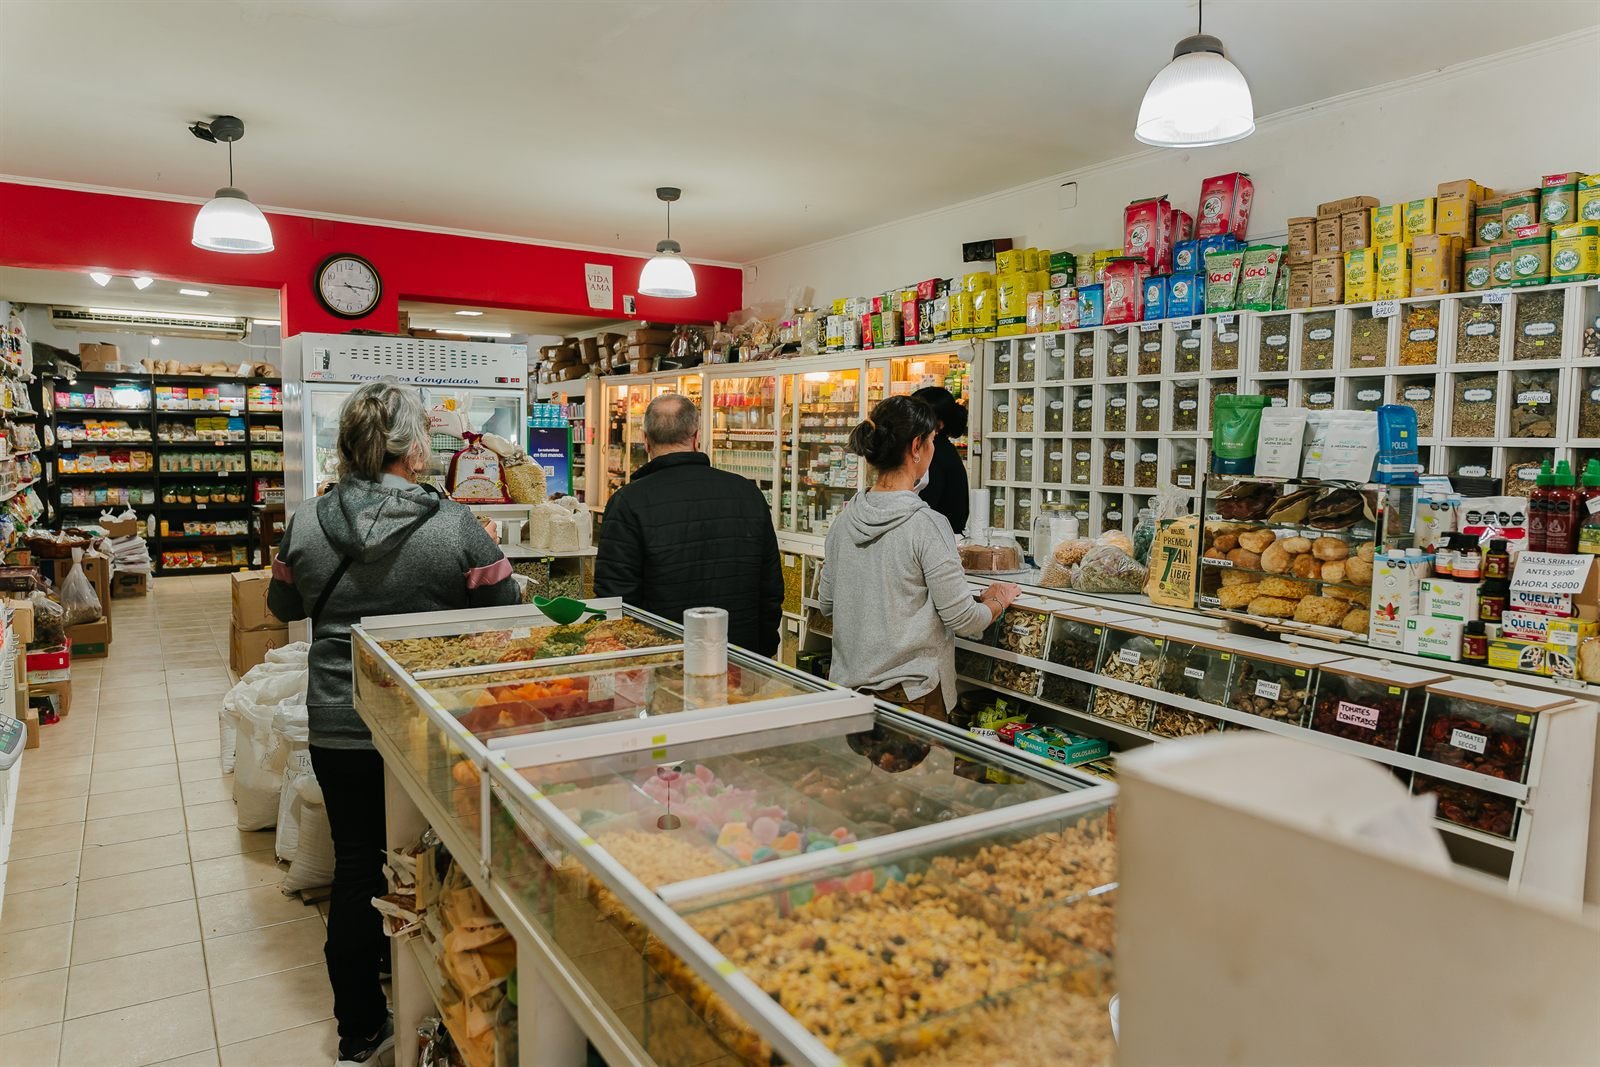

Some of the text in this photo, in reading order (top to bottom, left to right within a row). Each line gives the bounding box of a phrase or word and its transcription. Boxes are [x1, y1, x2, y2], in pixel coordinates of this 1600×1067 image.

[336, 264, 343, 272] 11
[344, 262, 354, 270] 12
[328, 272, 335, 280] 10
[365, 274, 370, 283] 2
[588, 274, 609, 283] VIDA
[591, 284, 610, 292] AMA
[415, 376, 479, 384] Congelados
[1522, 556, 1546, 564] SALSA
[1170, 569, 1191, 580] LIBRE
[1514, 579, 1580, 590] AHORA $6000
[1520, 592, 1562, 605] QUELAT
[1418, 637, 1448, 645] MAGNESIO
[1120, 656, 1139, 665] LAMINADO
[1258, 682, 1280, 690] SHIITAKE
[1341, 704, 1371, 717] TOMATES
[1339, 713, 1377, 727] CONFITADOS
[1454, 730, 1484, 744] TOMATES
[1458, 740, 1477, 751] SECOS
[1072, 748, 1101, 758] GOLOSANAS
